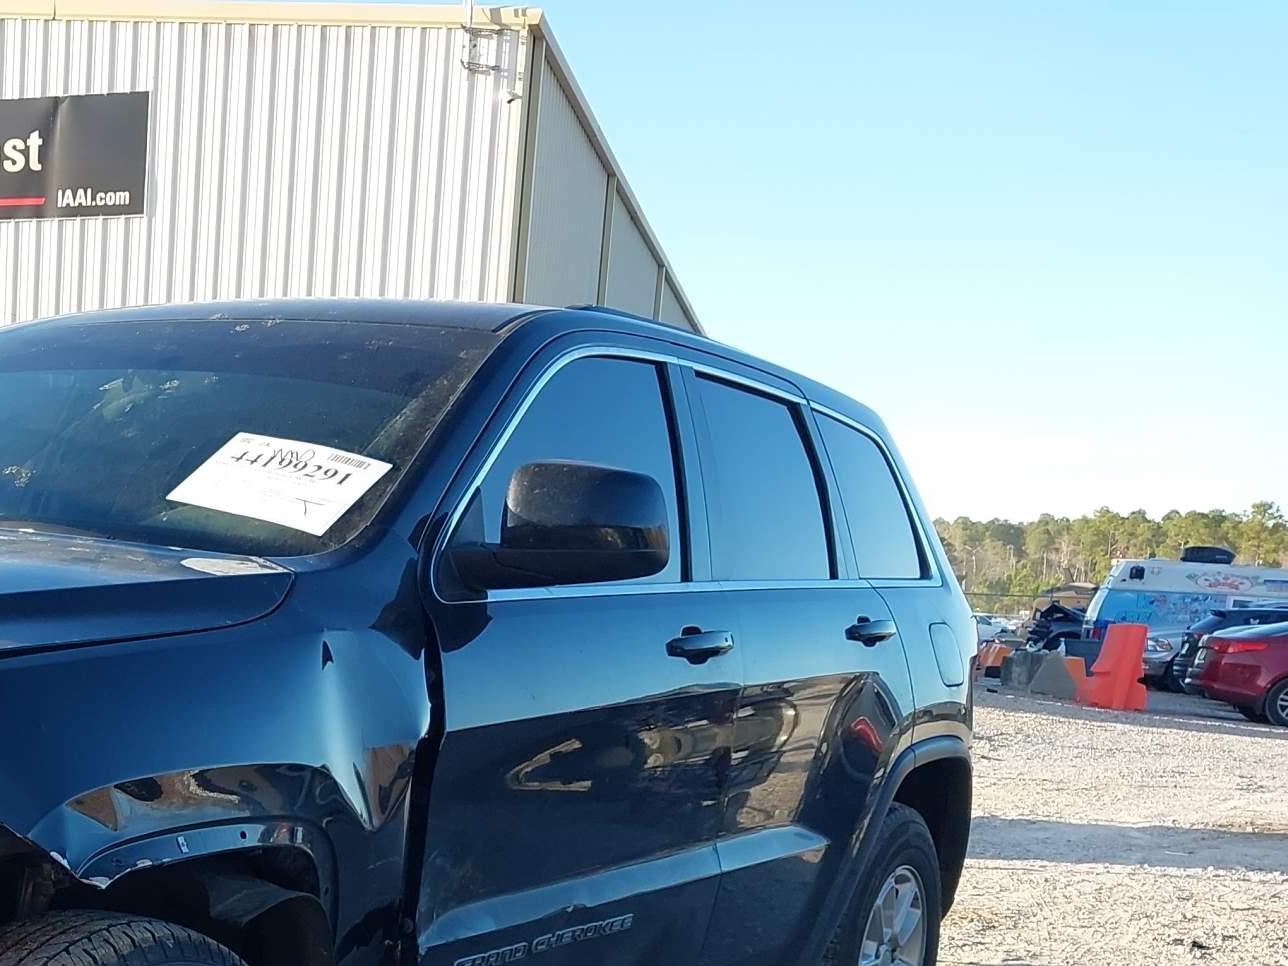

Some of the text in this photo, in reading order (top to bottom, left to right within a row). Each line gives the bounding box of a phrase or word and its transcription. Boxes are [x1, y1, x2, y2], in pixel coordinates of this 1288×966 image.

[56, 187, 131, 209] IAAI.com
[229, 449, 354, 485] 44199291
[531, 913, 634, 954] CHEROKEE
